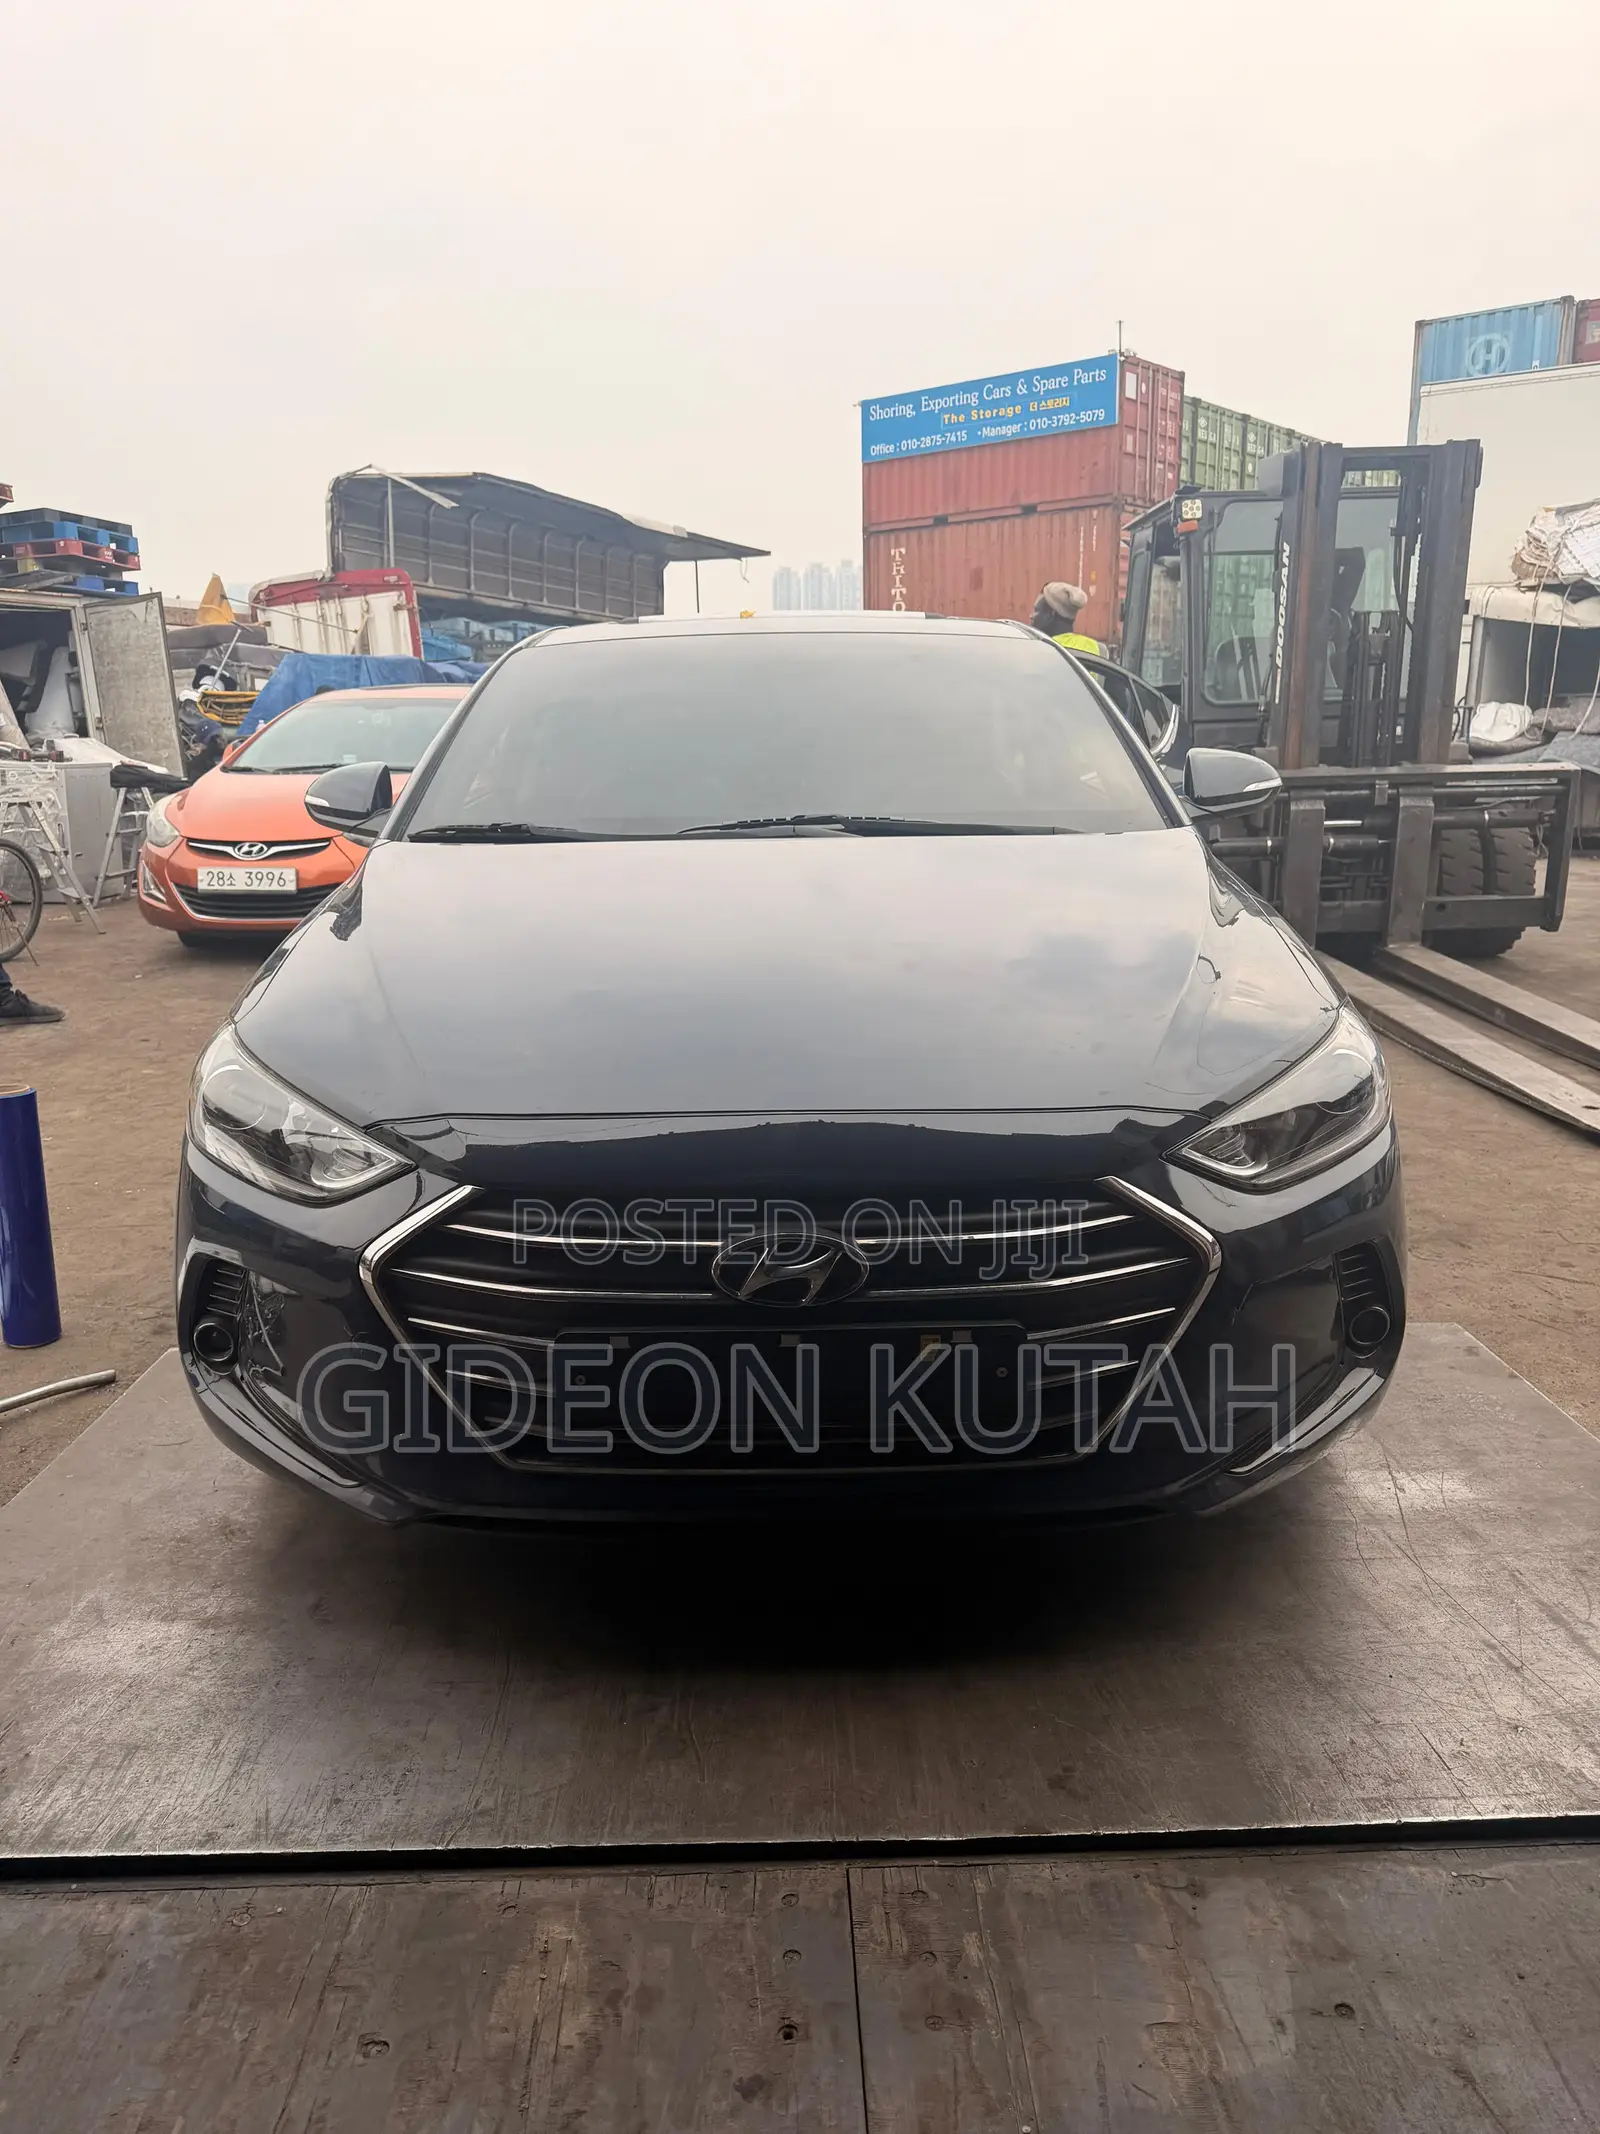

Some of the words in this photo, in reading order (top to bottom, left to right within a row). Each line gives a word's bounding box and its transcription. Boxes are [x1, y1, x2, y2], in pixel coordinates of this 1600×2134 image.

[870, 403, 916, 421] Shoring,
[921, 391, 979, 413] Exporting
[983, 384, 1012, 400] Cars
[1016, 378, 1028, 395] &
[1032, 375, 1069, 395] Spare
[1073, 368, 1107, 386] Parts
[943, 413, 965, 425] The
[971, 405, 1022, 420] Storage
[870, 443, 895, 456] Office
[901, 430, 968, 451] 010-2875-7415
[1029, 408, 1105, 430] 010-3792-5079
[1275, 541, 1290, 669] DOOSAN
[206, 871, 236, 887] 28소
[244, 871, 287, 888] 3996
